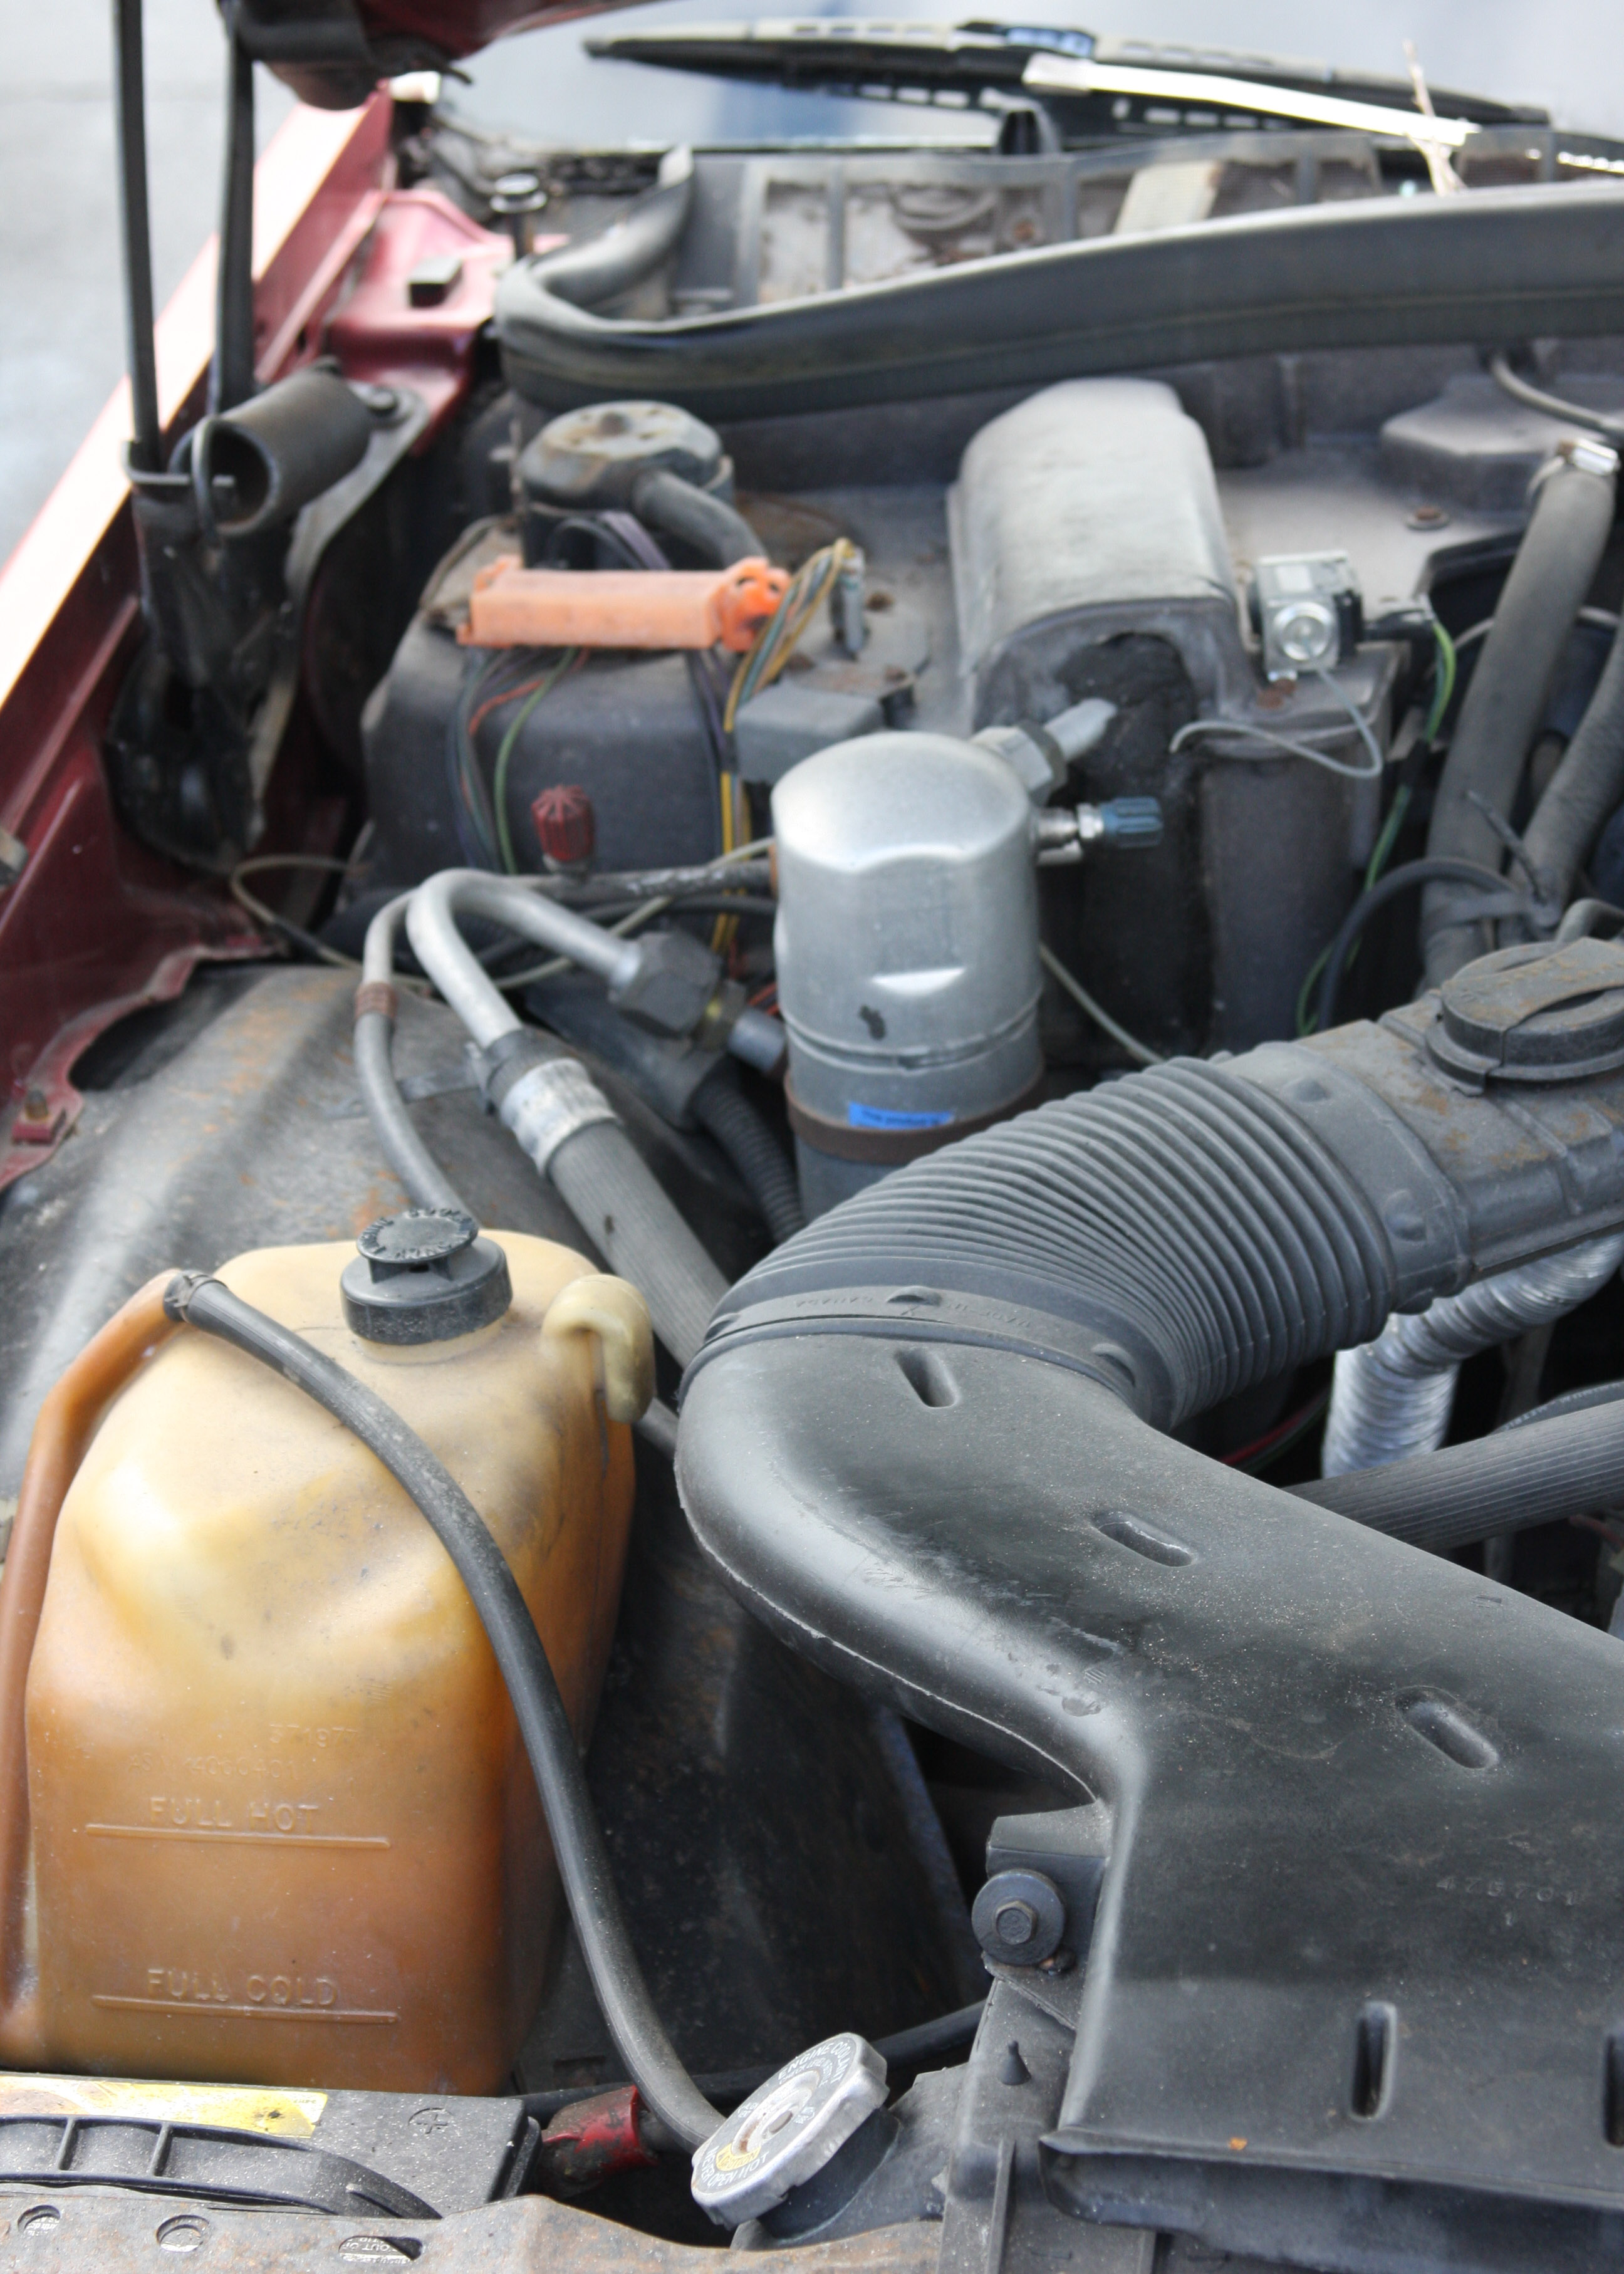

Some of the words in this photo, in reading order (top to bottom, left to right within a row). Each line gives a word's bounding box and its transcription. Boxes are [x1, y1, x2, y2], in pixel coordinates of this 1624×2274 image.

[149, 1796, 232, 1828] FULL
[249, 1801, 320, 1834] HOT
[147, 1966, 231, 2002] FULL
[246, 1973, 339, 2006] COLD
[778, 2042, 833, 2080] ENGINE
[830, 2041, 851, 2084] COOLANT
[701, 2144, 719, 2183] NEVER
[707, 2169, 737, 2187] OPEN
[735, 2151, 769, 2179] HOT
